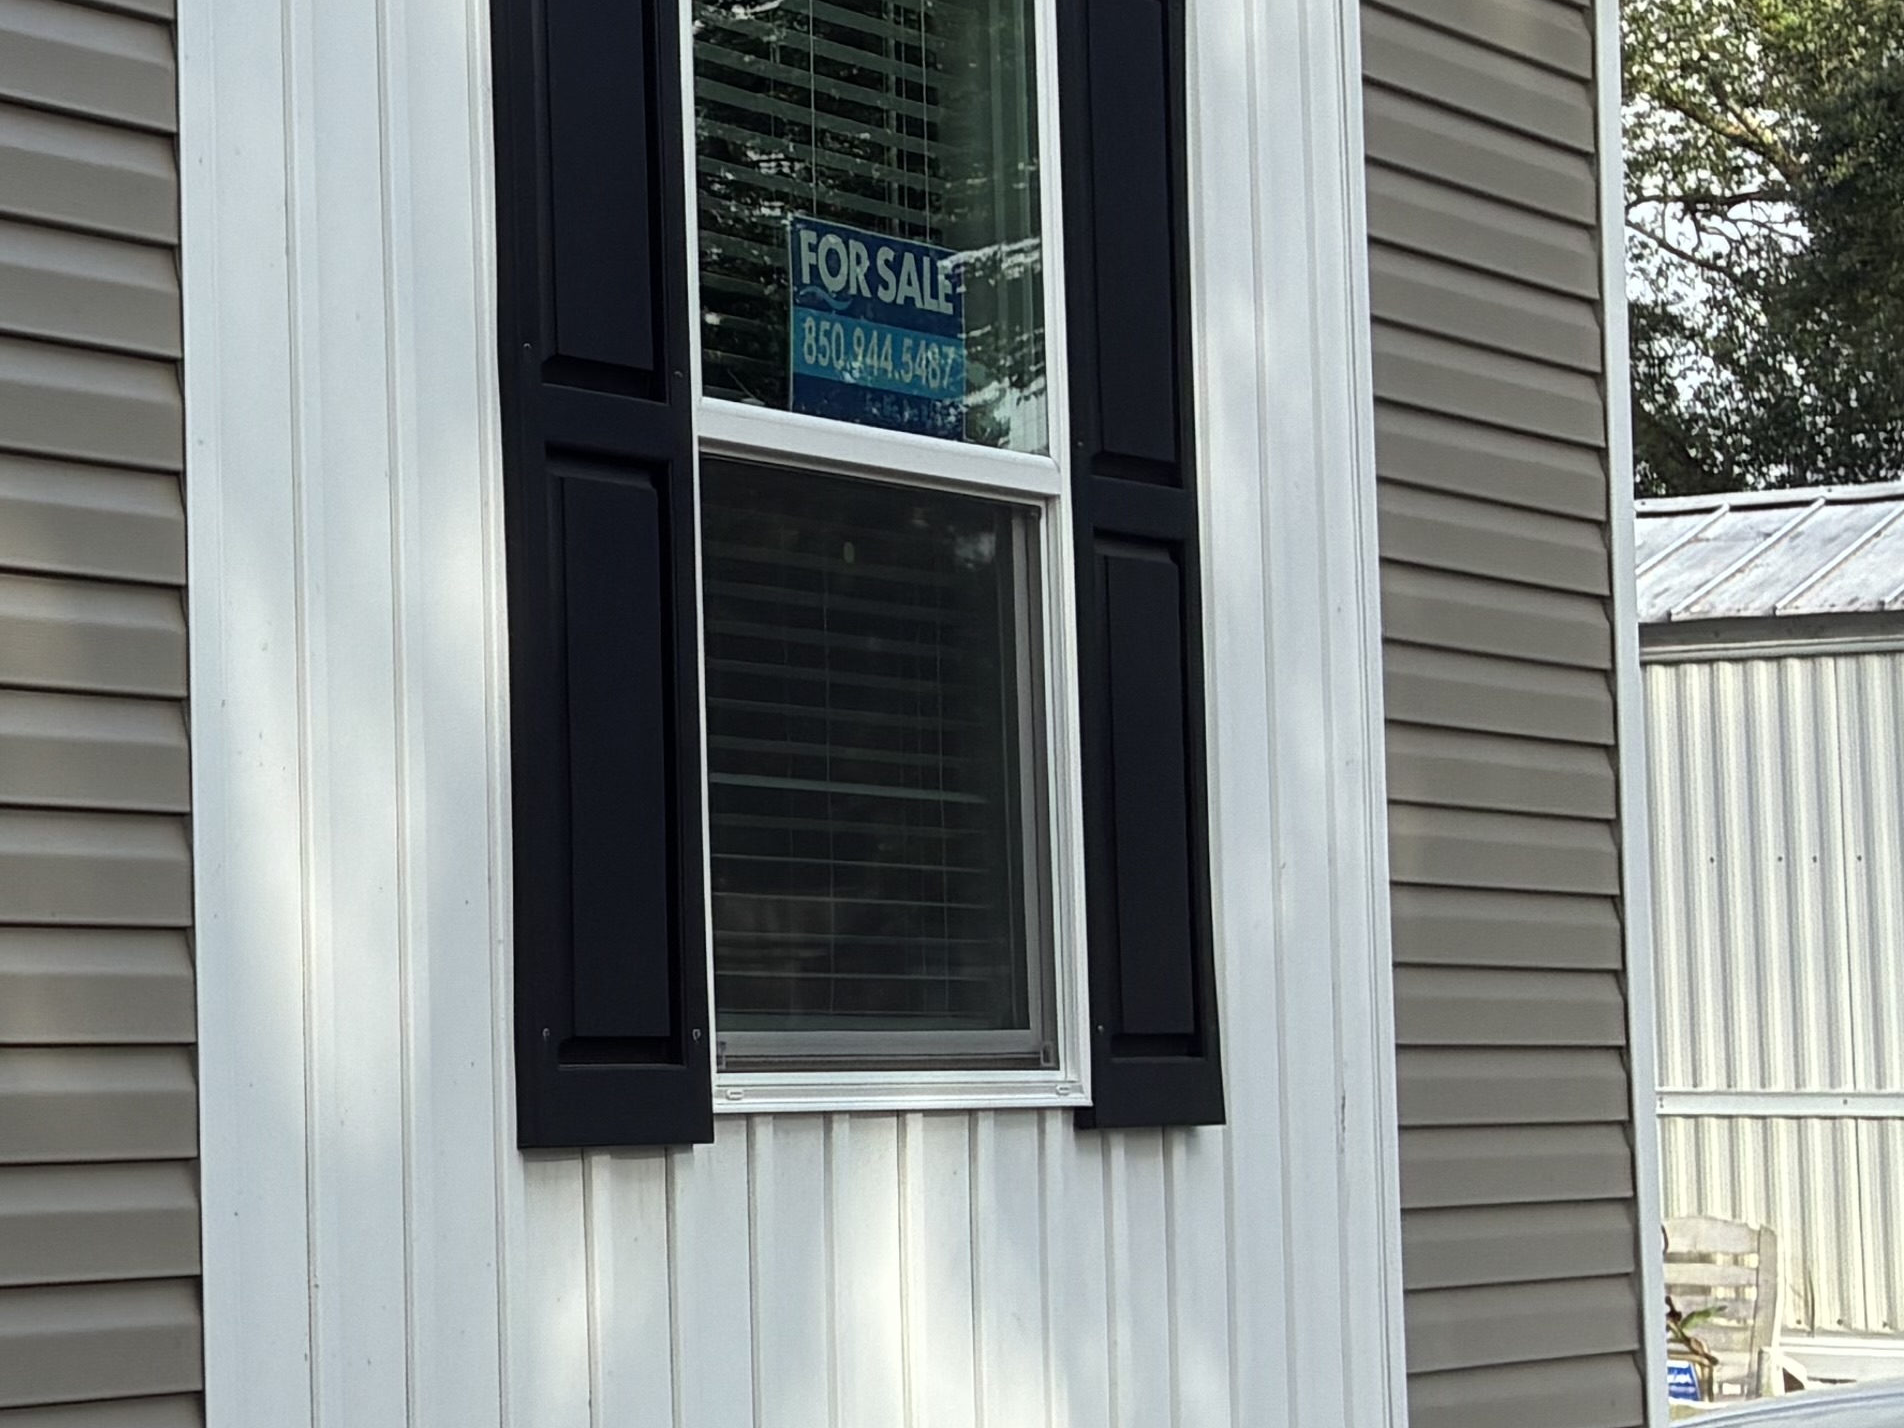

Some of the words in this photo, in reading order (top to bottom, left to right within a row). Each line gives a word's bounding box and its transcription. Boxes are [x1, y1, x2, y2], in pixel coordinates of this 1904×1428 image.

[799, 228, 872, 298] FOR
[877, 246, 954, 315] SALE
[802, 316, 957, 390] 850.944.5487
